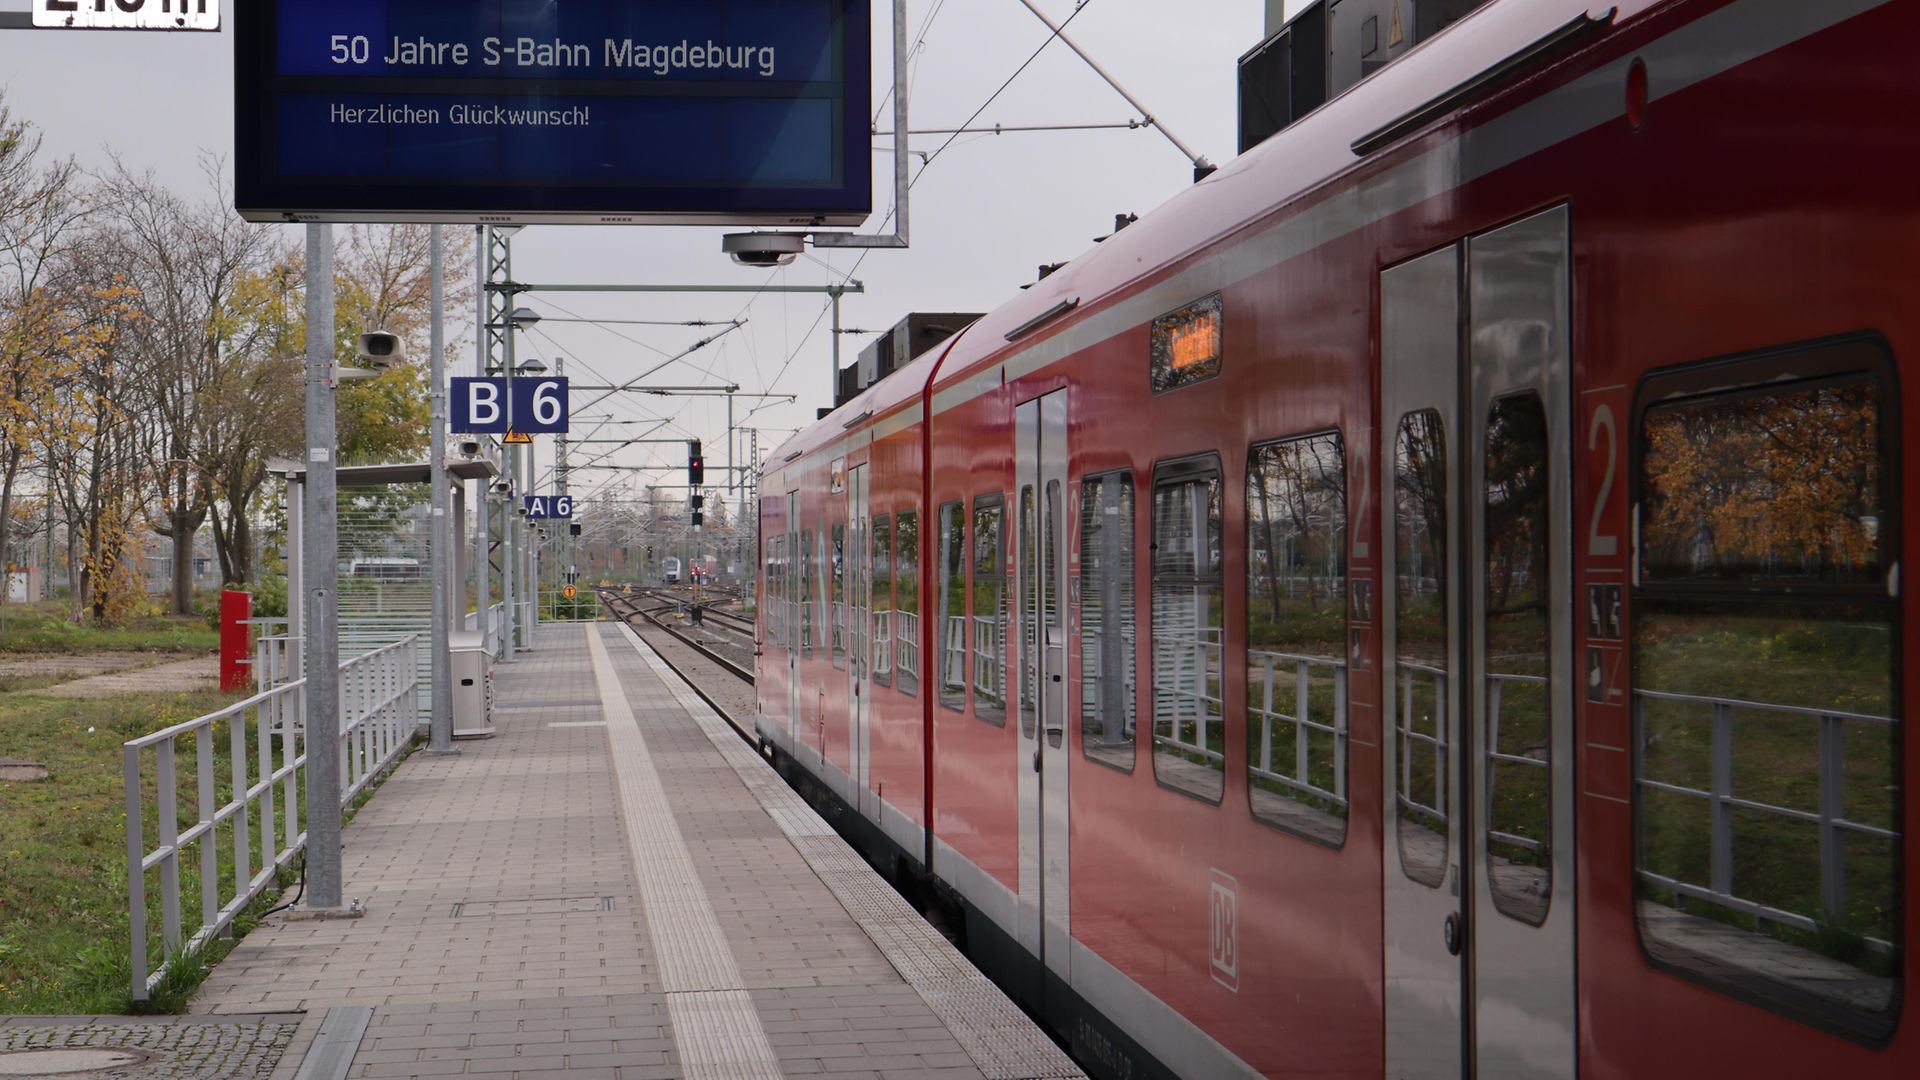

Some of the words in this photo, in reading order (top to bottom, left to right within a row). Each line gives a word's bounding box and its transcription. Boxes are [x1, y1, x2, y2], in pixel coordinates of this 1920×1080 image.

[330, 35, 369, 64] 50
[384, 36, 469, 65] Jahre
[483, 37, 590, 66] S-Bahn
[604, 38, 775, 76] Magdeburg
[330, 103, 439, 124] Herzlichen
[449, 105, 589, 125] Glückwunsch!
[469, 382, 500, 424] B
[532, 381, 561, 425] 6
[529, 498, 545, 515] A
[557, 497, 570, 516] 6
[1352, 441, 1369, 558] 2
[1588, 404, 1618, 556] 2
[1006, 499, 1013, 564] 2
[1070, 488, 1079, 563] 2
[1211, 883, 1236, 976] DB
